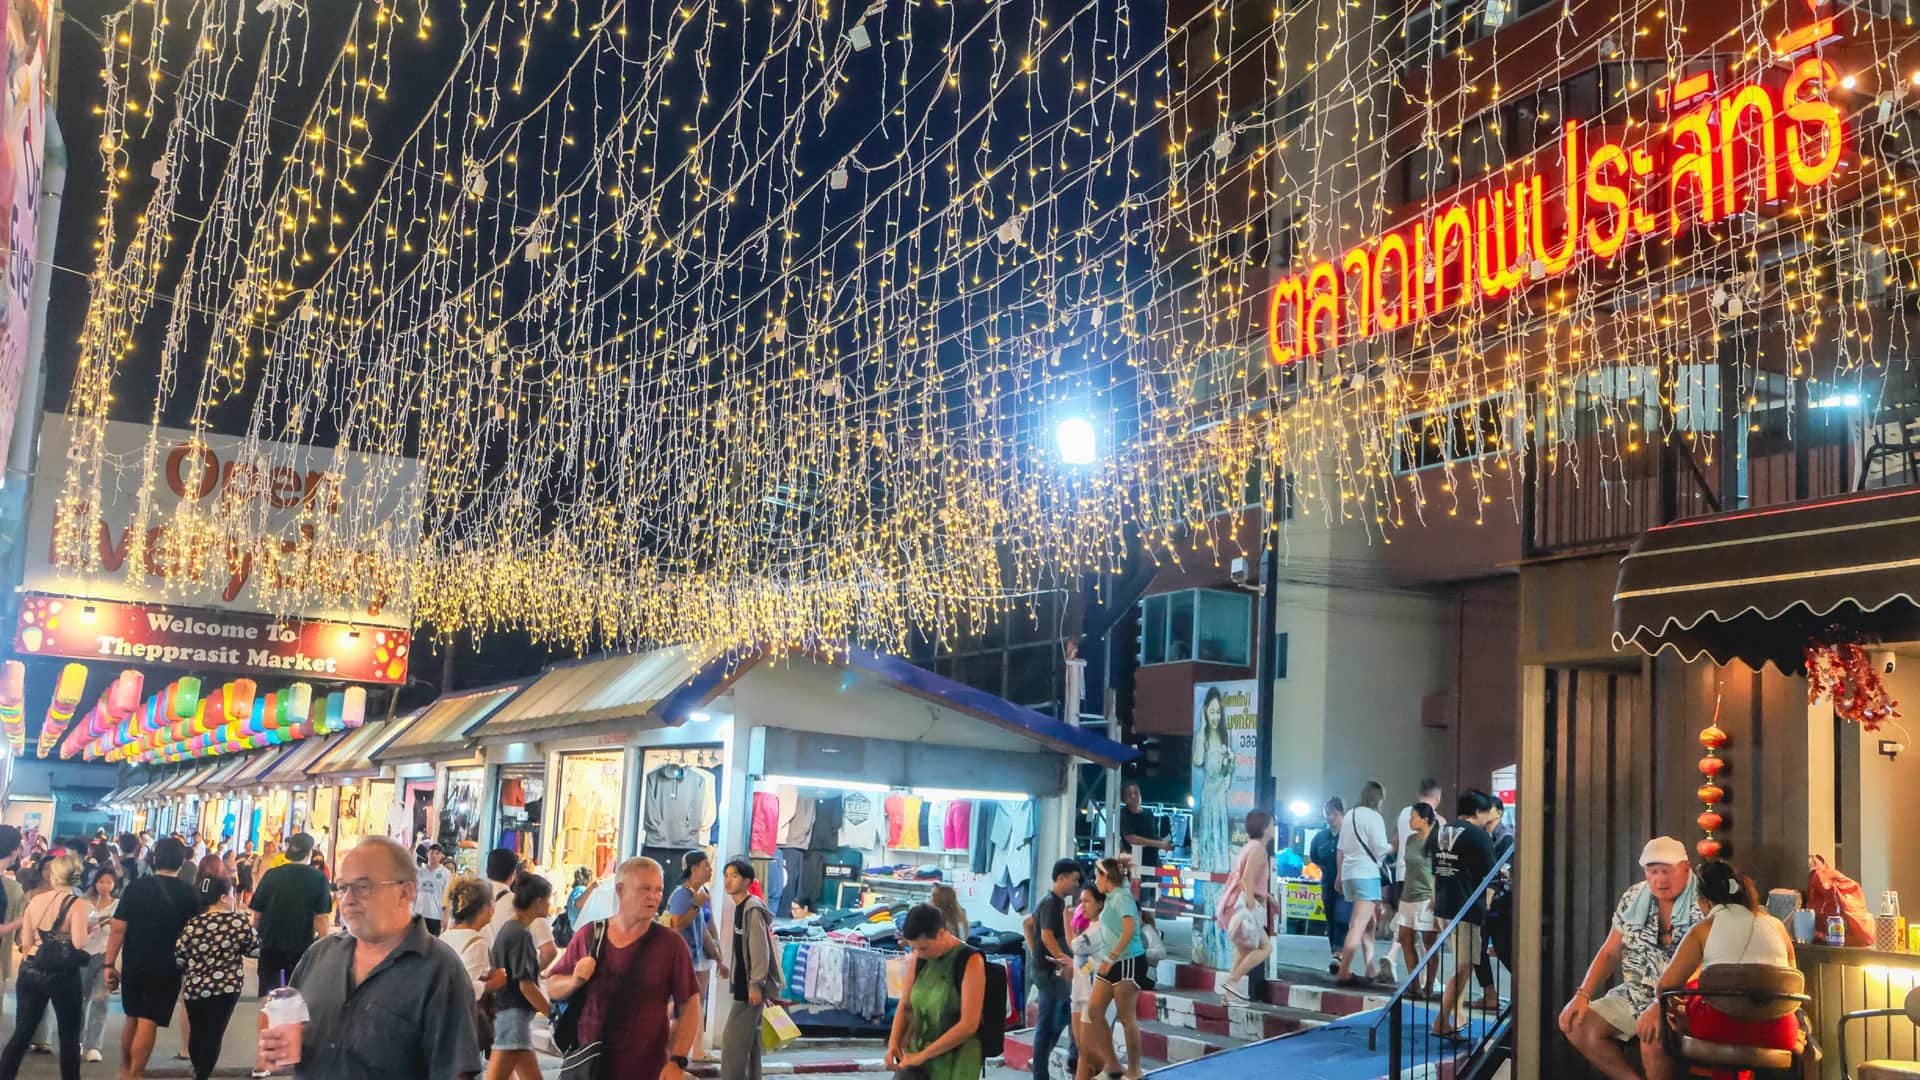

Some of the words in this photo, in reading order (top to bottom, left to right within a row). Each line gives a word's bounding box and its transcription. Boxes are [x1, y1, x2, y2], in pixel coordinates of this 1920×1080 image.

[165, 441, 339, 520] Open
[47, 499, 398, 616] Eveydy
[96, 635, 240, 665] Thepprasit
[245, 648, 337, 673] Market
[147, 612, 258, 640] Welcome
[265, 623, 297, 644] To
